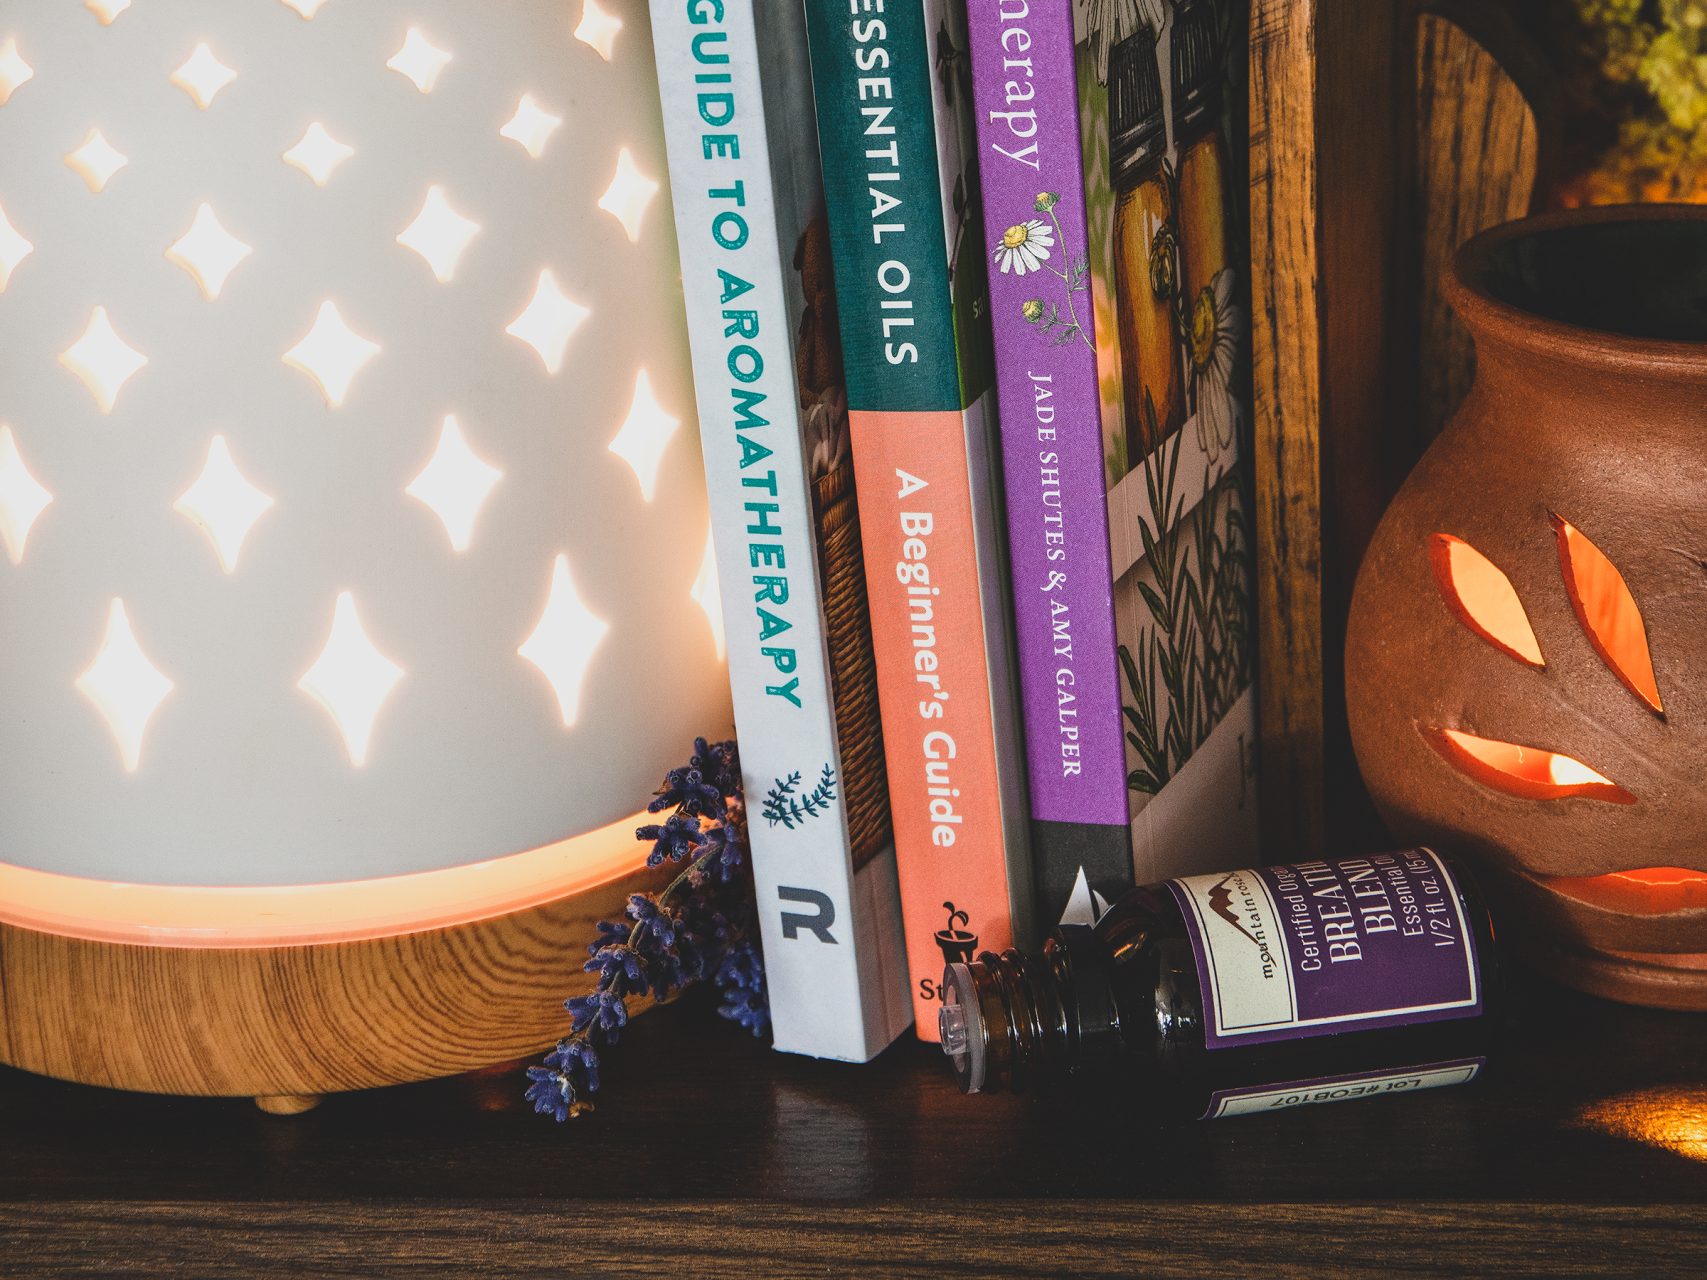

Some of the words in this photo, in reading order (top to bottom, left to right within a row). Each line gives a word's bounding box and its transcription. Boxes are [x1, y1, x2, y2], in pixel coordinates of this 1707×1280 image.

[707, 179, 750, 251] TO
[877, 259, 919, 365] OILS
[1027, 370, 1057, 442] JADE
[716, 268, 802, 709] AROMATHERAPY
[895, 468, 929, 499] A
[1039, 451, 1066, 561] SHUTES
[896, 511, 950, 719] Beginner's
[1039, 569, 1067, 592] &
[1050, 598, 1073, 661] AMY
[1055, 667, 1082, 778] GALPER
[923, 731, 963, 847] Guide
[777, 885, 839, 945] R
[1338, 859, 1397, 935] BLEND
[1380, 866, 1425, 936] Essential
[1422, 876, 1440, 894] oz.
[1425, 898, 1447, 915] fl.
[1244, 898, 1278, 980] mountain
[1283, 895, 1322, 971] Certified
[1430, 918, 1456, 947] 1/2
[1386, 1079, 1422, 1091] Lot
